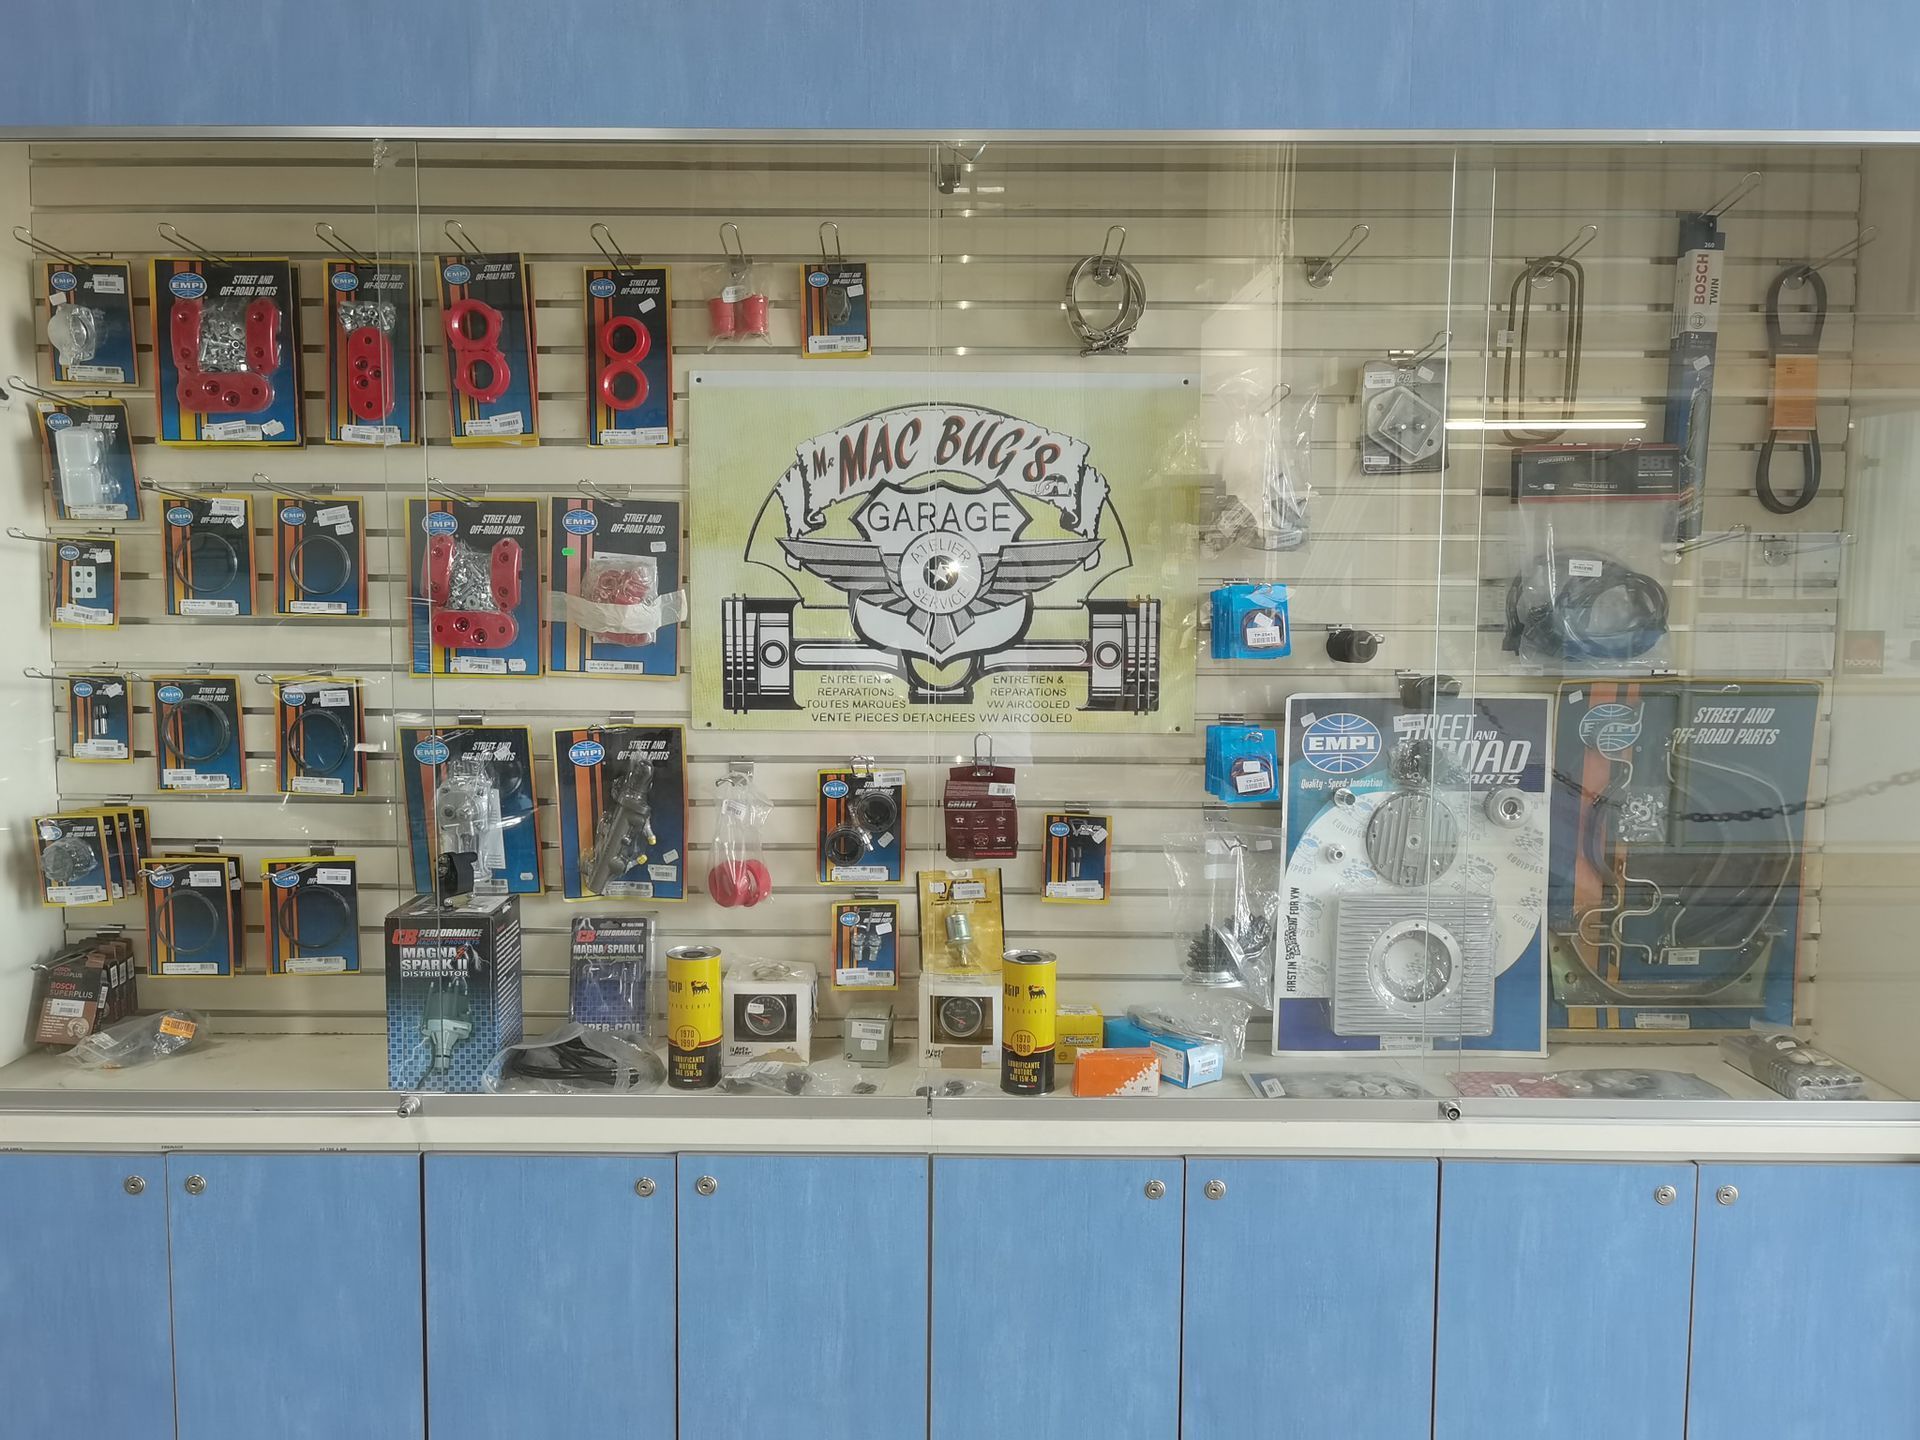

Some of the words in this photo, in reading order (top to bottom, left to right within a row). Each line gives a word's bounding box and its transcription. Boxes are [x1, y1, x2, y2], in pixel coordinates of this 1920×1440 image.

[446, 270, 469, 279] EMPI
[1694, 254, 1709, 305] BOSCH
[232, 275, 258, 285] STREET
[258, 275, 274, 284] AND
[333, 278, 357, 286] EMPI
[171, 281, 204, 290] EMPI
[220, 286, 254, 296] OFF-ROAD
[254, 286, 278, 296] PARTS
[1709, 278, 1719, 305] TWIN
[839, 417, 922, 495] MAC
[934, 415, 1061, 482] BUG'S
[1638, 455, 1673, 469] BBT
[481, 514, 505, 524] STREET
[507, 515, 522, 524] AND
[623, 513, 646, 523] STREET
[646, 514, 662, 523] AND
[867, 502, 1011, 532] GARAGE
[469, 525, 502, 535] OFF-ROAD
[502, 526, 525, 535] PARTS
[610, 524, 642, 534] OFF-ROAD
[642, 525, 665, 534] PARTS
[910, 538, 971, 564] ATELIER
[912, 587, 970, 610] SERVICE
[820, 674, 880, 684] ENTRETIEN
[993, 675, 1054, 685] ENTRETIEN
[1056, 675, 1064, 683] &
[817, 687, 895, 697] REPARATIONS
[990, 687, 1067, 697] REPARATIONS
[806, 699, 849, 709] TOUTES
[852, 699, 906, 709] MARQUES
[987, 699, 1004, 709] VW
[1006, 699, 1070, 709] AIRCOOLED
[811, 712, 851, 722] VENTE
[855, 712, 899, 723] PIECES
[902, 712, 975, 723] DETACHEES
[979, 713, 999, 723] VW
[1002, 713, 1073, 723] AIRCOOLED
[1693, 707, 1744, 724] STREET
[1742, 708, 1775, 724] AND
[1474, 731, 1497, 740] AND
[1732, 729, 1780, 745] PARTS
[473, 742, 496, 751] STREET
[628, 740, 651, 749] STREET
[651, 740, 666, 749] AND
[1309, 735, 1375, 751] EMPI
[647, 752, 670, 760] PARTS
[1301, 779, 1324, 790] Quality
[1328, 778, 1347, 789] Speed
[1350, 778, 1383, 787] Innovation
[1466, 774, 1522, 785] ARTS
[947, 800, 978, 808] GRANT
[1291, 887, 1300, 899] VW
[1290, 901, 1299, 914] FOR
[392, 929, 419, 945] CB
[418, 928, 483, 937] PERFORMANCE
[402, 947, 457, 958] MAGNA
[573, 944, 604, 953] MAGNA
[607, 944, 636, 953] SPARK
[638, 944, 644, 953] II
[402, 959, 453, 970] SPARK
[457, 959, 468, 969] II
[1287, 961, 1297, 970] IN
[51, 982, 75, 990] BOSCH
[1286, 972, 1296, 992] FIRST
[49, 989, 93, 999] SUPERPLUS
[583, 1023, 641, 1033] PER-COIL
[680, 1029, 694, 1038] 1970
[1016, 1034, 1031, 1043] 1970
[680, 1039, 694, 1047] 1990
[1016, 1044, 1031, 1053] 1990
[1008, 1060, 1040, 1069] LUBRIFICANTE
